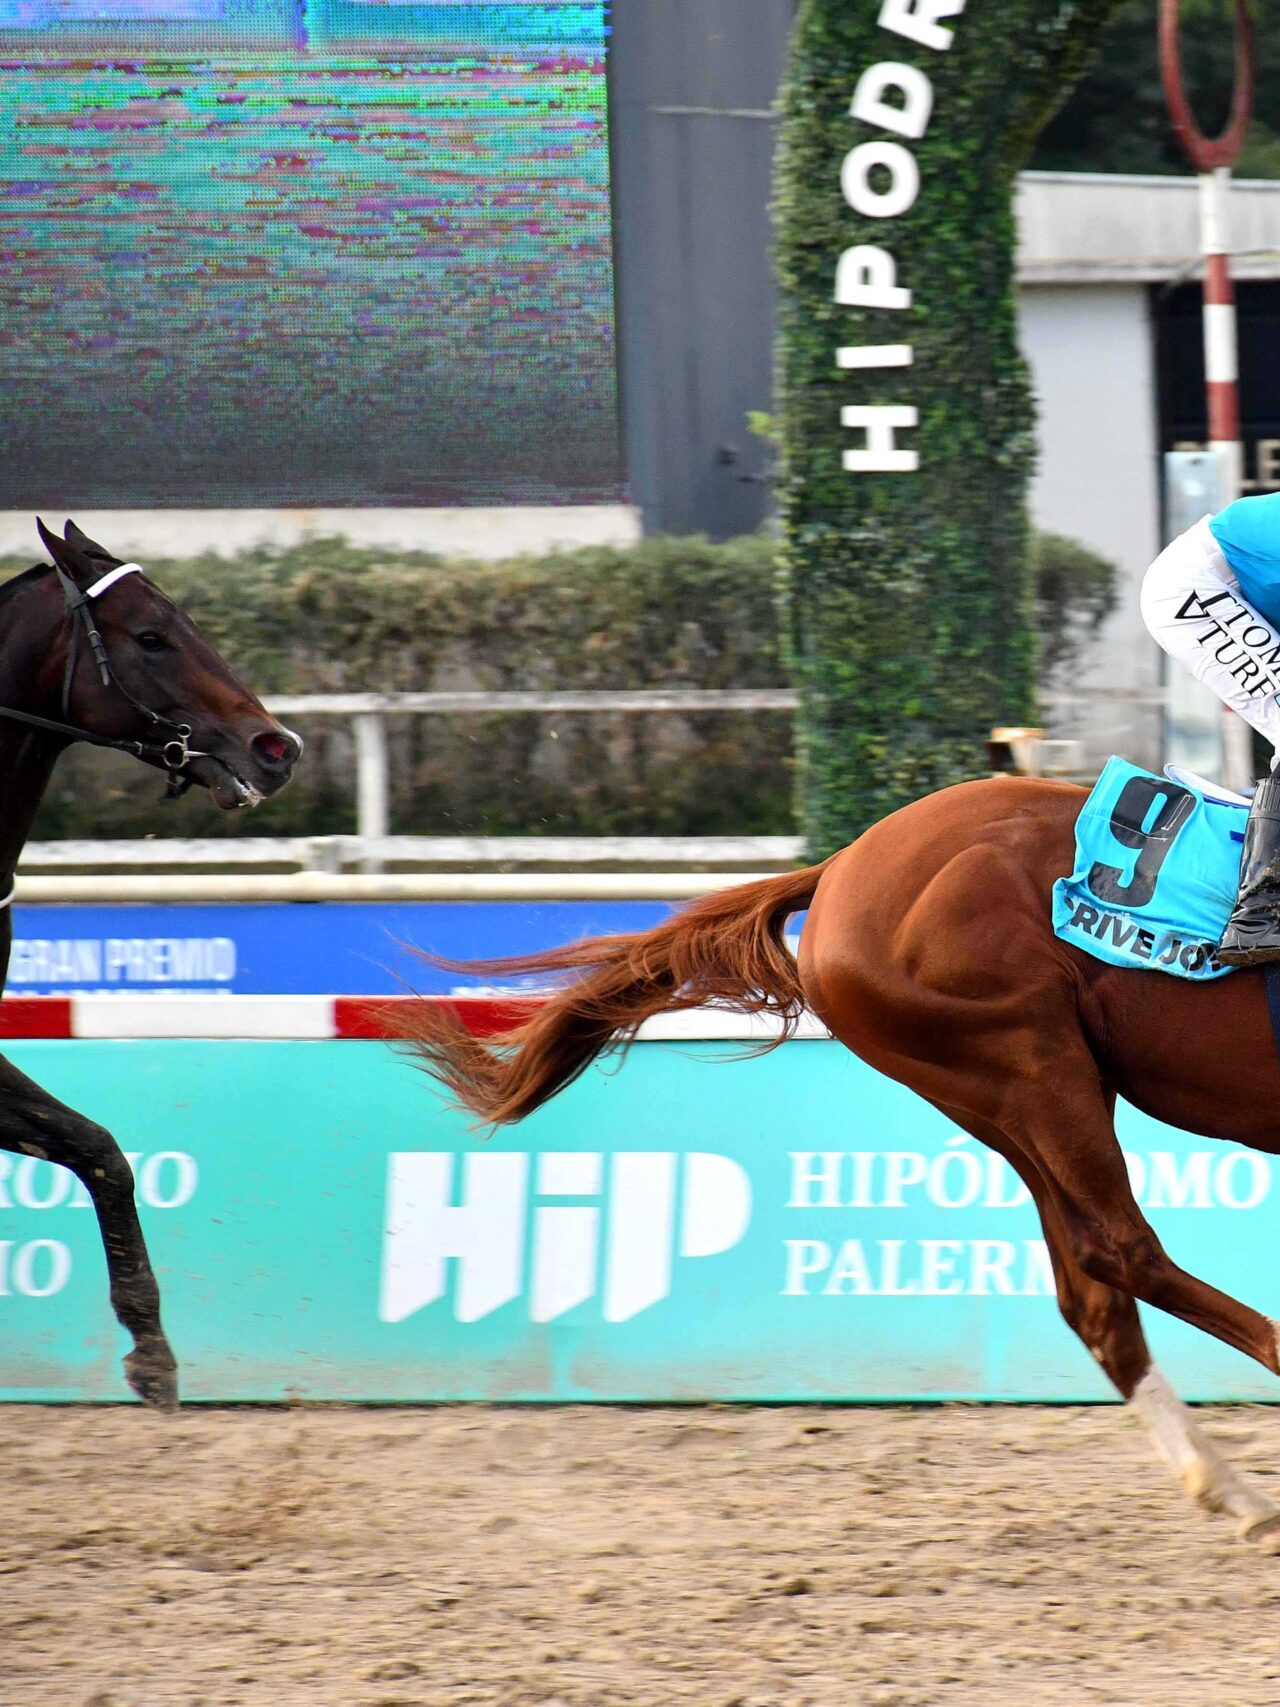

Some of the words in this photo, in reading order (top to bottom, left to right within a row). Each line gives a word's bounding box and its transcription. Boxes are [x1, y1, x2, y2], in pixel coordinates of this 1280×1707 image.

[1197, 618, 1277, 699] TURF
[1088, 776, 1197, 907] 9
[9, 938, 101, 983] GRAN
[105, 937, 236, 982] PREMIO
[787, 1134, 1271, 1209] HIPÓDMO
